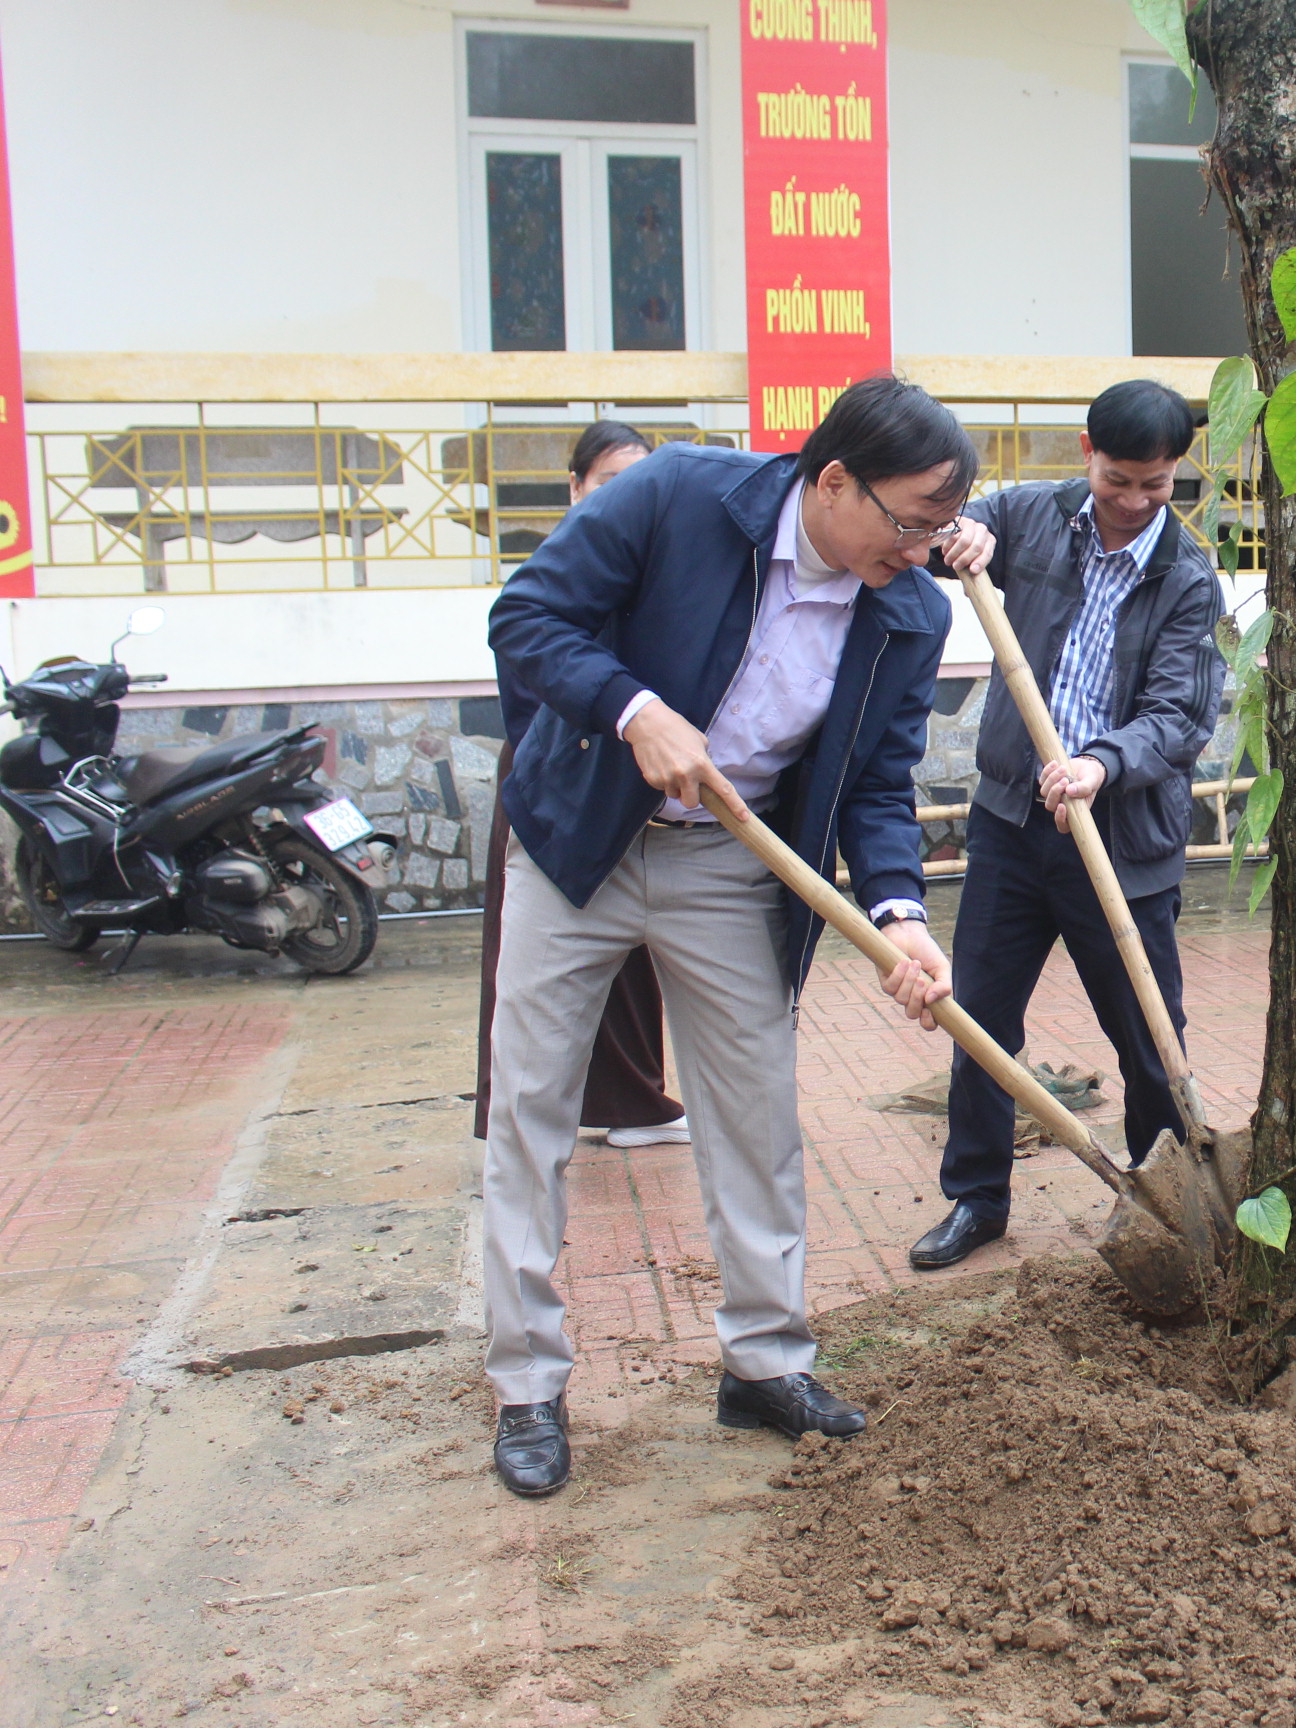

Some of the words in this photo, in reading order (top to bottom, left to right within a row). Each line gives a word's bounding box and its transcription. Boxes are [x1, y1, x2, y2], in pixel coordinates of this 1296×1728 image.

[757, 83, 831, 139] TRƯỜNG
[835, 82, 871, 140] TỒN
[770, 176, 806, 236] ĐẤT
[811, 184, 861, 237] NƯỚC
[766, 274, 817, 333] PHỒN
[821, 290, 870, 339] VINH,
[763, 387, 813, 440] HẠNH
